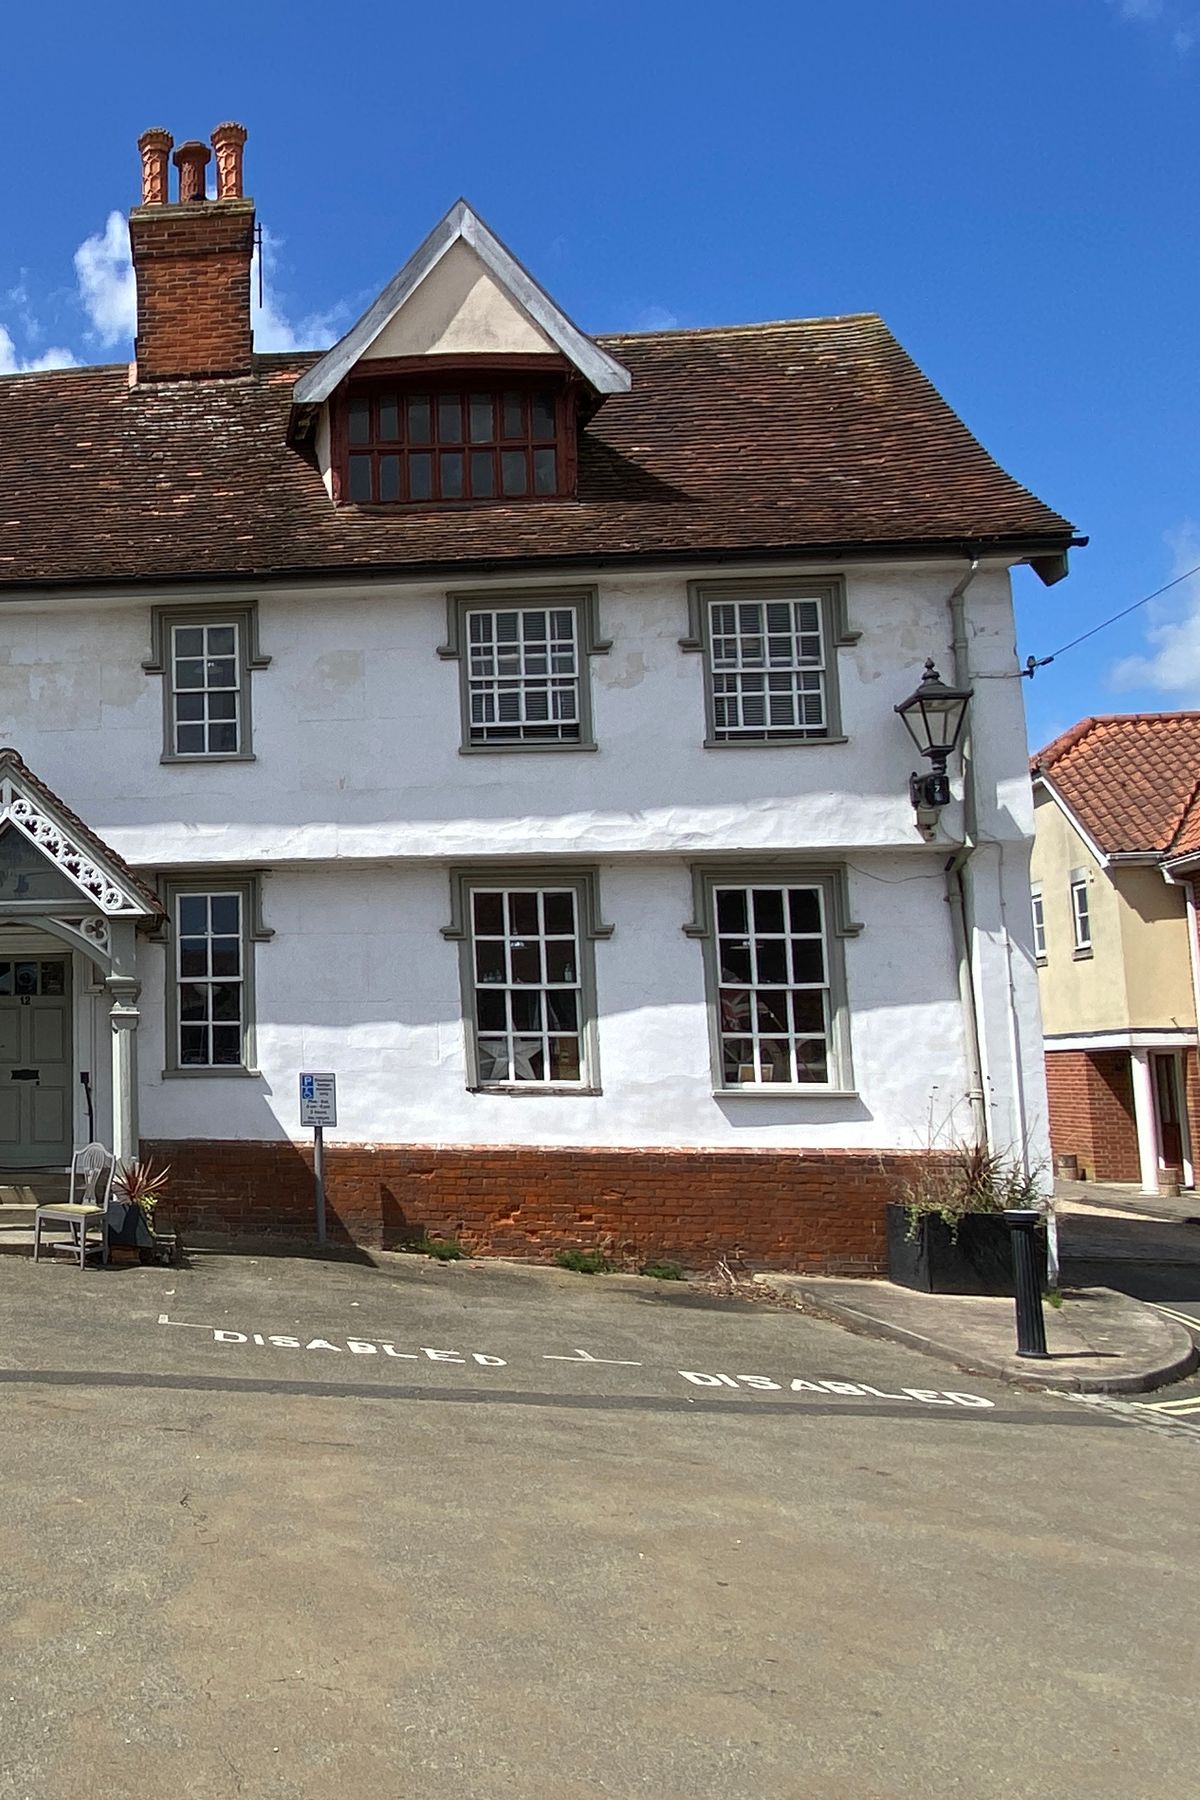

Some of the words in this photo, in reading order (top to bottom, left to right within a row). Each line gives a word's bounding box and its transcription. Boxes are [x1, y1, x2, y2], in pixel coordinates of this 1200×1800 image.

[20, 995, 31, 1006] 12
[304, 1076, 312, 1086] P
[213, 1329, 508, 1367] DISABLED
[678, 1370, 995, 1408] DISABLED
